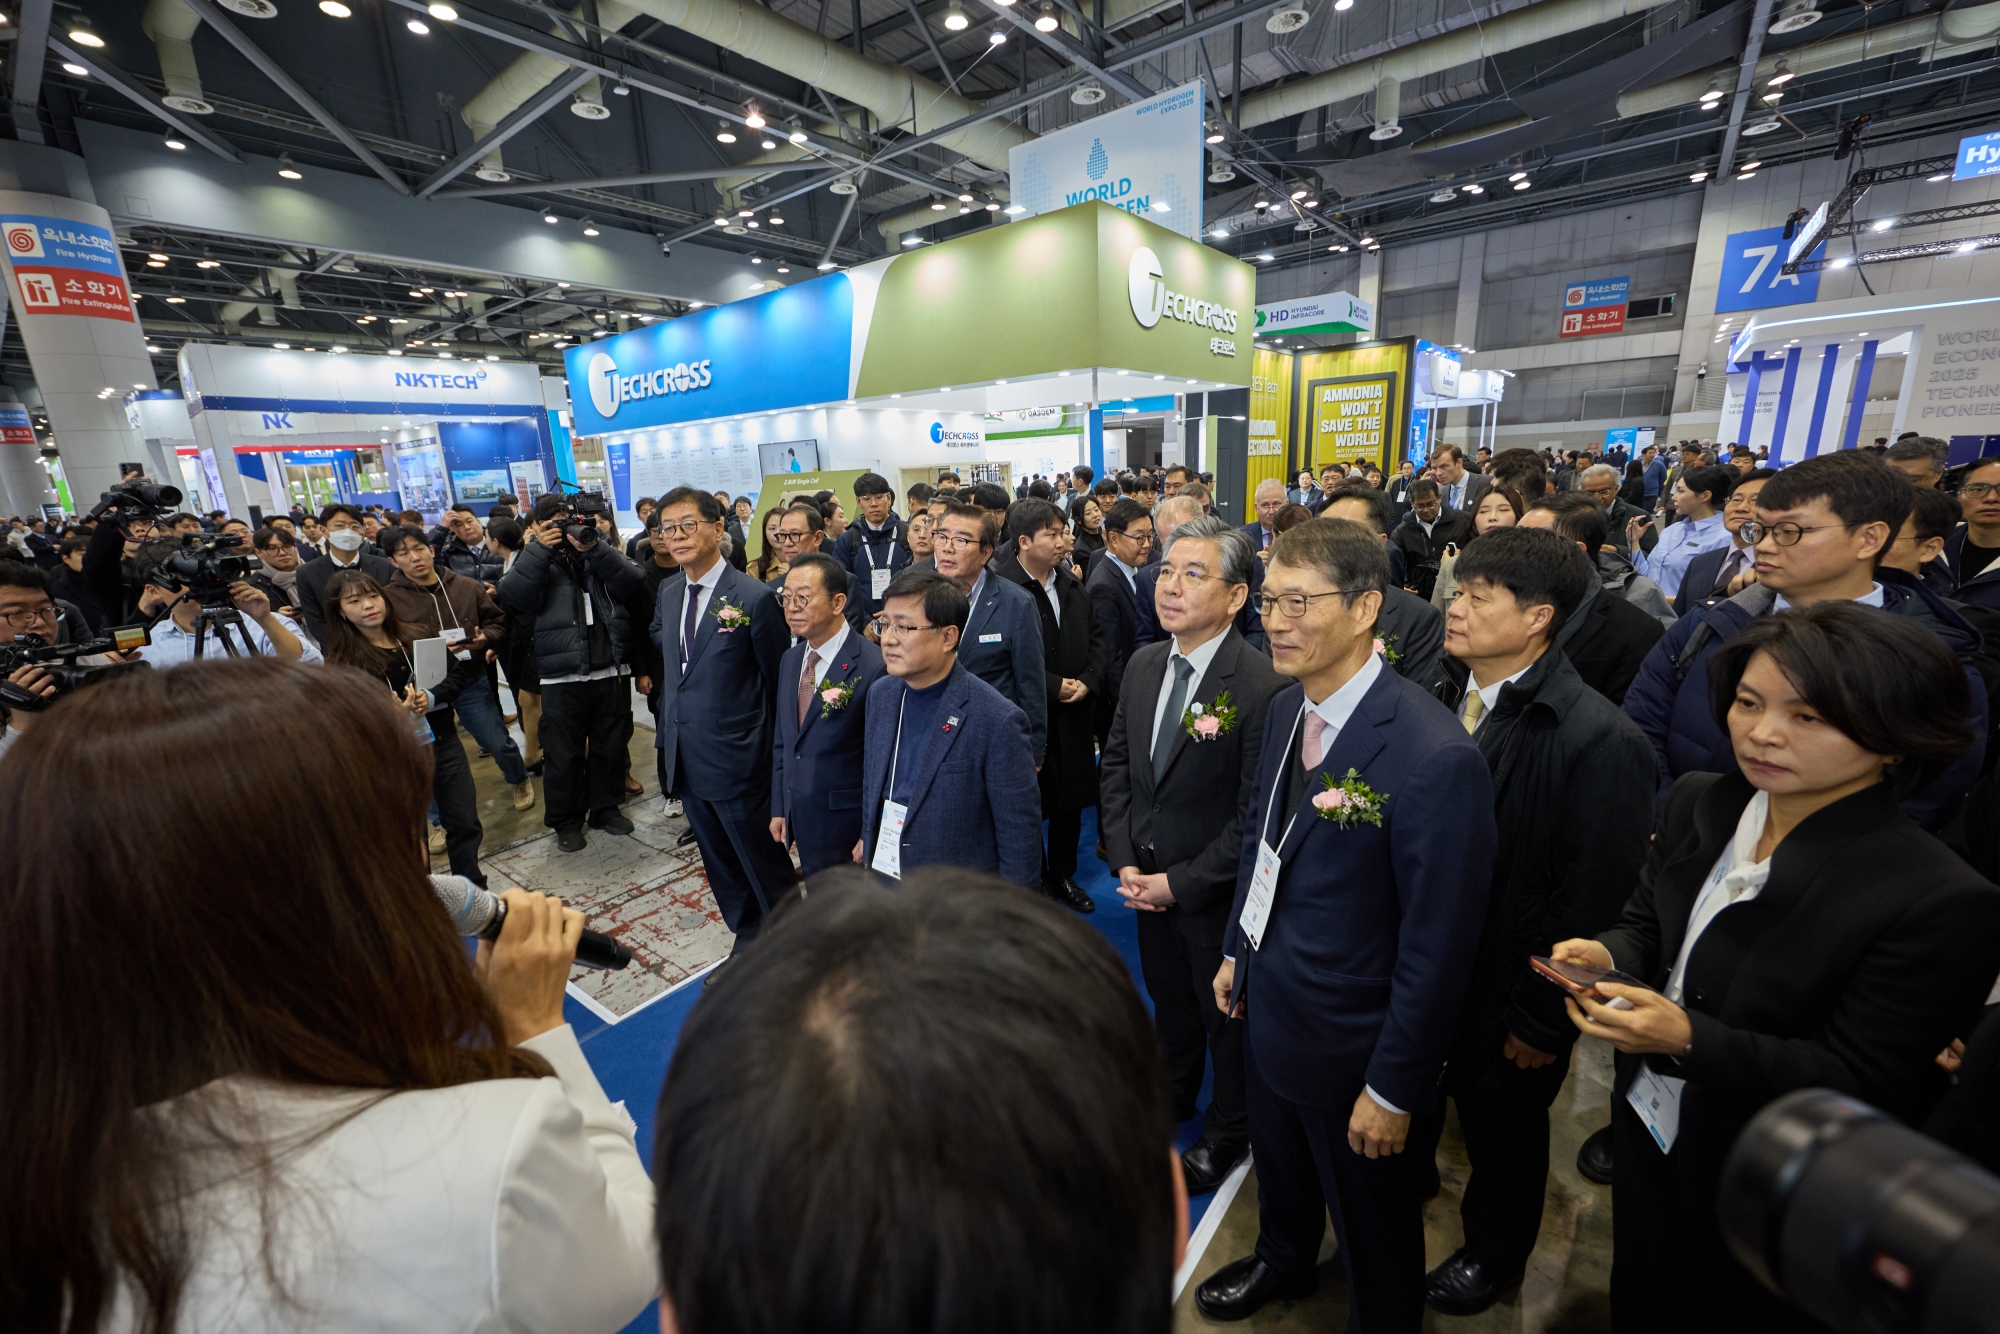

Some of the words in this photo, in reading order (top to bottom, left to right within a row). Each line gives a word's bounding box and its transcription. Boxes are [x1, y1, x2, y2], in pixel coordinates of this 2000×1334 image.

[1136, 103, 1158, 115] WORLD
[1159, 90, 1194, 107] HYDROGEN
[1160, 104, 1177, 115] EXPO
[1178, 98, 1194, 109] 2025
[1965, 145, 2000, 164] Hy
[1066, 178, 1132, 207] WORLD
[42, 227, 114, 253] 옥내소화전
[56, 249, 75, 258] Fire
[77, 251, 112, 264] Hydrant
[1128, 246, 1238, 334] TECHCROSS
[1587, 282, 1627, 294] 옥내소화전
[62, 297, 81, 305] Fire
[83, 298, 131, 312] Extinguisher
[1291, 305, 1319, 314] HYUNDAI
[1270, 310, 1289, 322] HD
[1291, 309, 1325, 320] INFRACORE
[1210, 337, 1236, 356] 테크로스
[1933, 347, 2000, 364] ECON
[395, 372, 478, 389] NKTECH
[1928, 367, 1979, 383] 2025
[588, 352, 712, 418] TECHCROSS
[1264, 377, 1278, 394] Tech
[1323, 384, 1383, 403] AMMONIA
[1340, 400, 1383, 417] WON'T
[261, 412, 294, 429] NK
[1321, 418, 1353, 433] SAVE
[1356, 416, 1381, 431] THE
[930, 421, 979, 444] TECHCROSS
[1335, 432, 1380, 448] WORLD
[1248, 440, 1282, 456] ECTROLYSIS
[797, 478, 810, 486] Single
